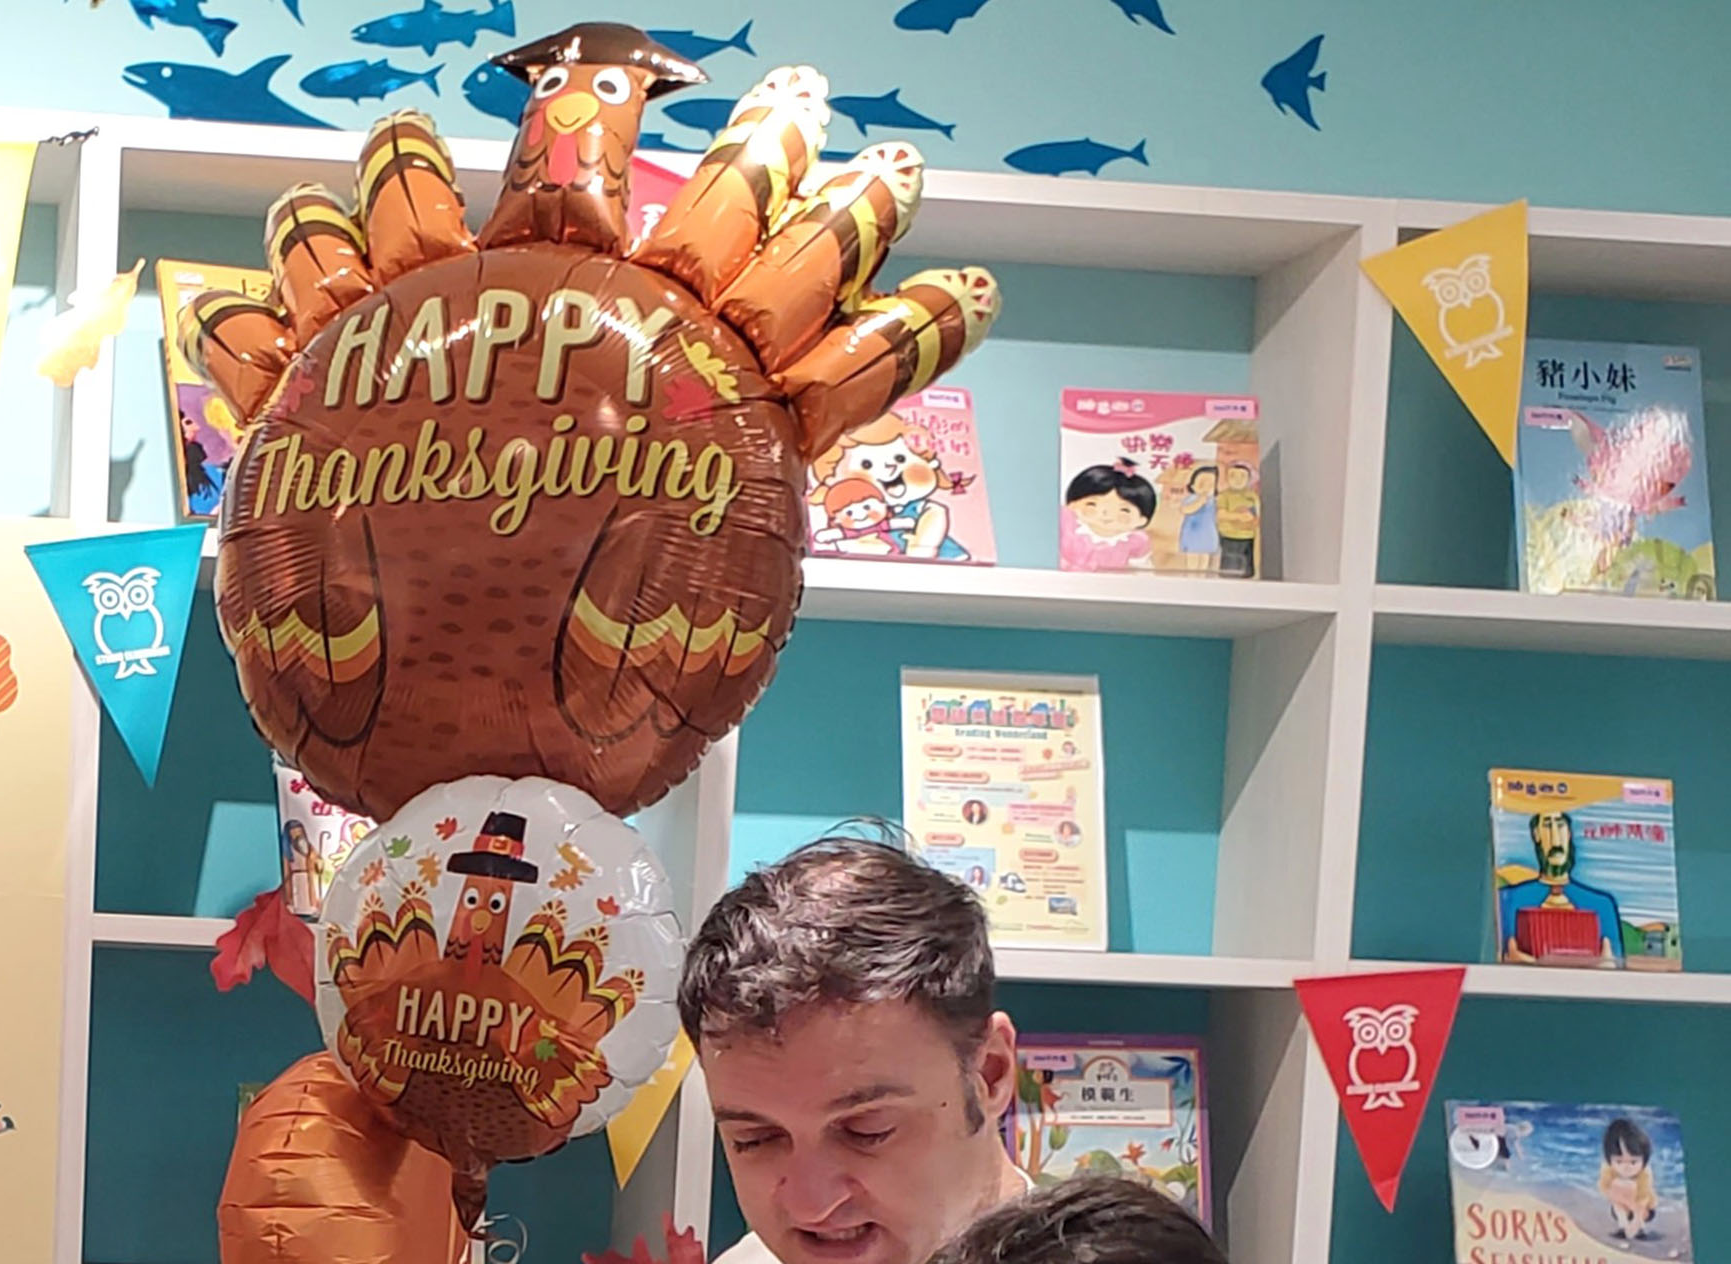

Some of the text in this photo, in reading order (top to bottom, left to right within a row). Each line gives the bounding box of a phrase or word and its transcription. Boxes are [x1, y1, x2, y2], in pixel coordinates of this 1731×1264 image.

[324, 288, 675, 410] HAPPY
[1538, 358, 1637, 393] 豬小妹
[252, 414, 742, 536] Thanksgiving
[395, 985, 536, 1054] HAPPY
[381, 1036, 541, 1092] Thanksgiving
[1467, 1203, 1568, 1248] SORA'S
